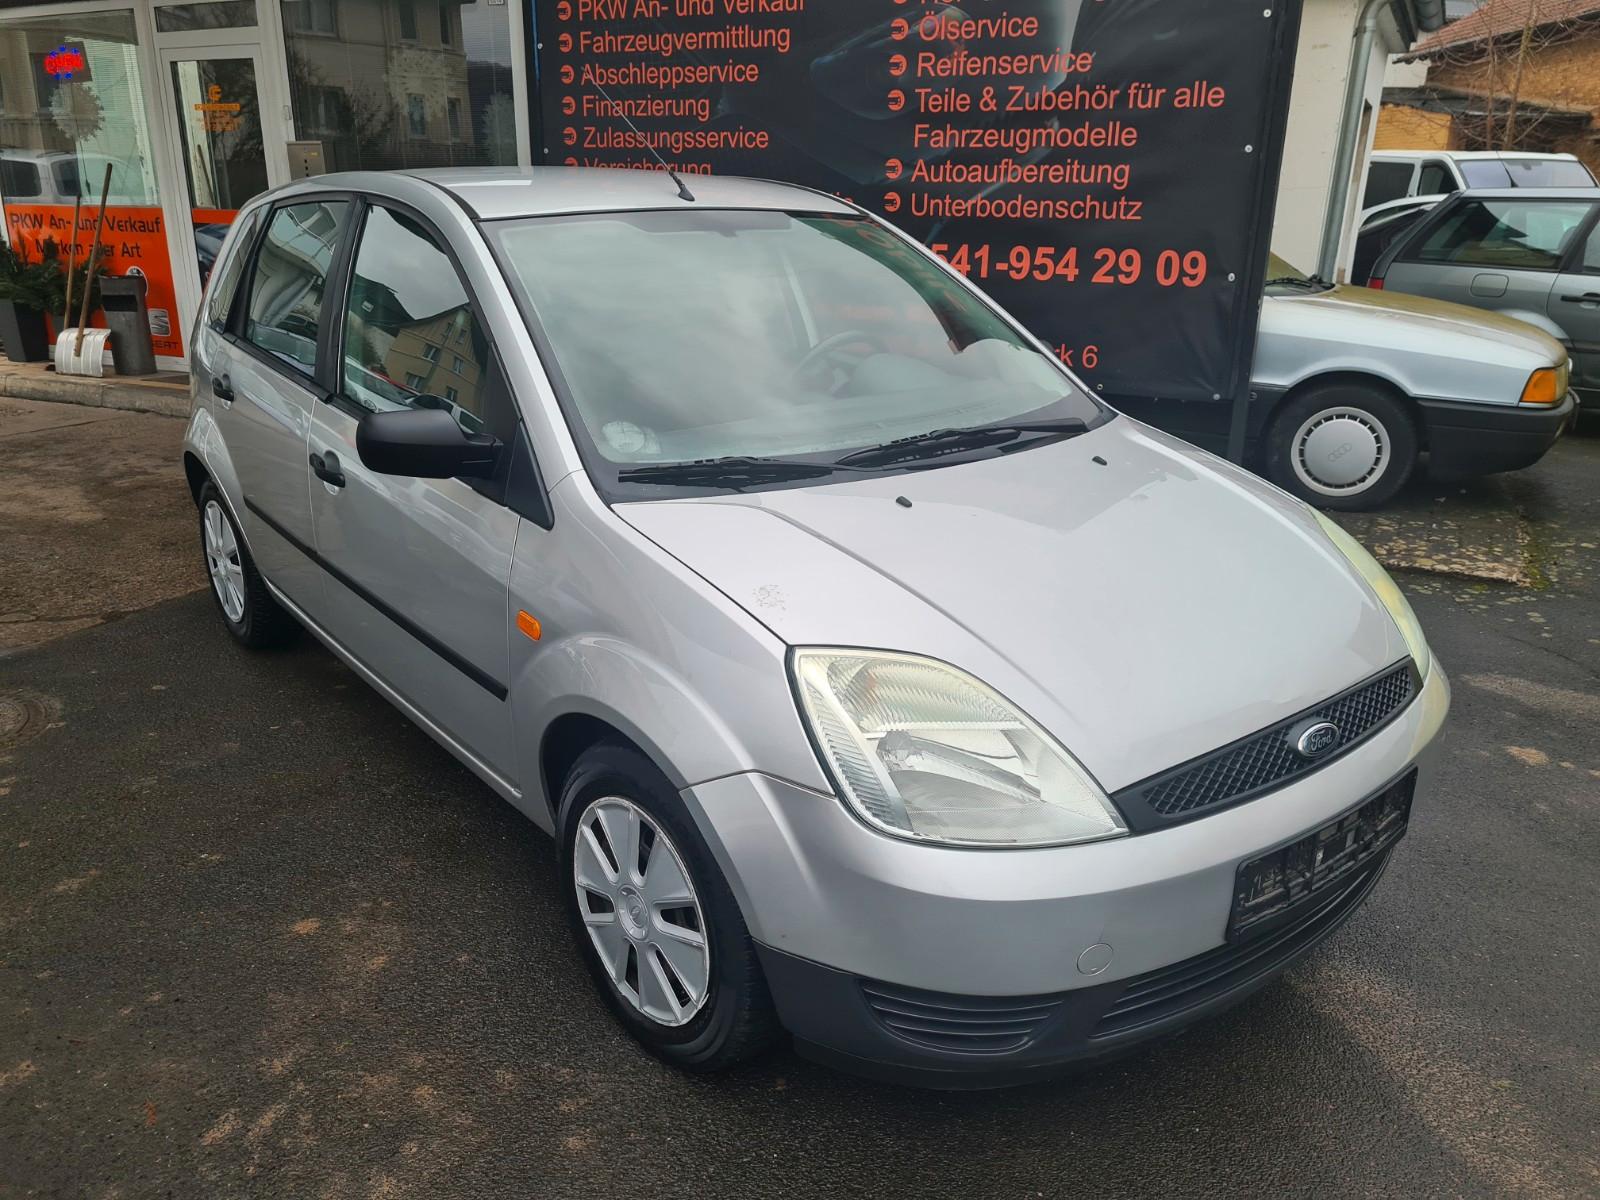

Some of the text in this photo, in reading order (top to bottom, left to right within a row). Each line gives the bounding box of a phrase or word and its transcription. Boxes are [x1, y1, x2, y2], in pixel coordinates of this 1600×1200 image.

[579, 0, 627, 20] PKW
[633, 0, 668, 18] An-
[675, 0, 714, 16] und
[580, 26, 791, 56] Fahrzeugvermittlung
[919, 12, 1039, 42] Ölservice
[581, 59, 760, 89] Abschleppservice
[917, 47, 1093, 77] Reifenservice
[582, 95, 710, 121] Finanzierung
[916, 81, 1225, 113] Teile & Zubehör für alle
[583, 126, 769, 153] Zulassungsservice
[913, 121, 1138, 153] Fahrzeugmodelle
[911, 158, 1131, 190] Autoaufbereitung
[911, 193, 1142, 221] Unterbodenschutz
[10, 212, 43, 229] PKW
[49, 214, 71, 230] An-
[105, 216, 160, 233] Verkauf
[121, 241, 142, 258] Art
[1092, 248, 1142, 284] 29
[1155, 250, 1207, 287] 09
[1082, 345, 1098, 368] 6
[1311, 729, 1332, 750] Ford
